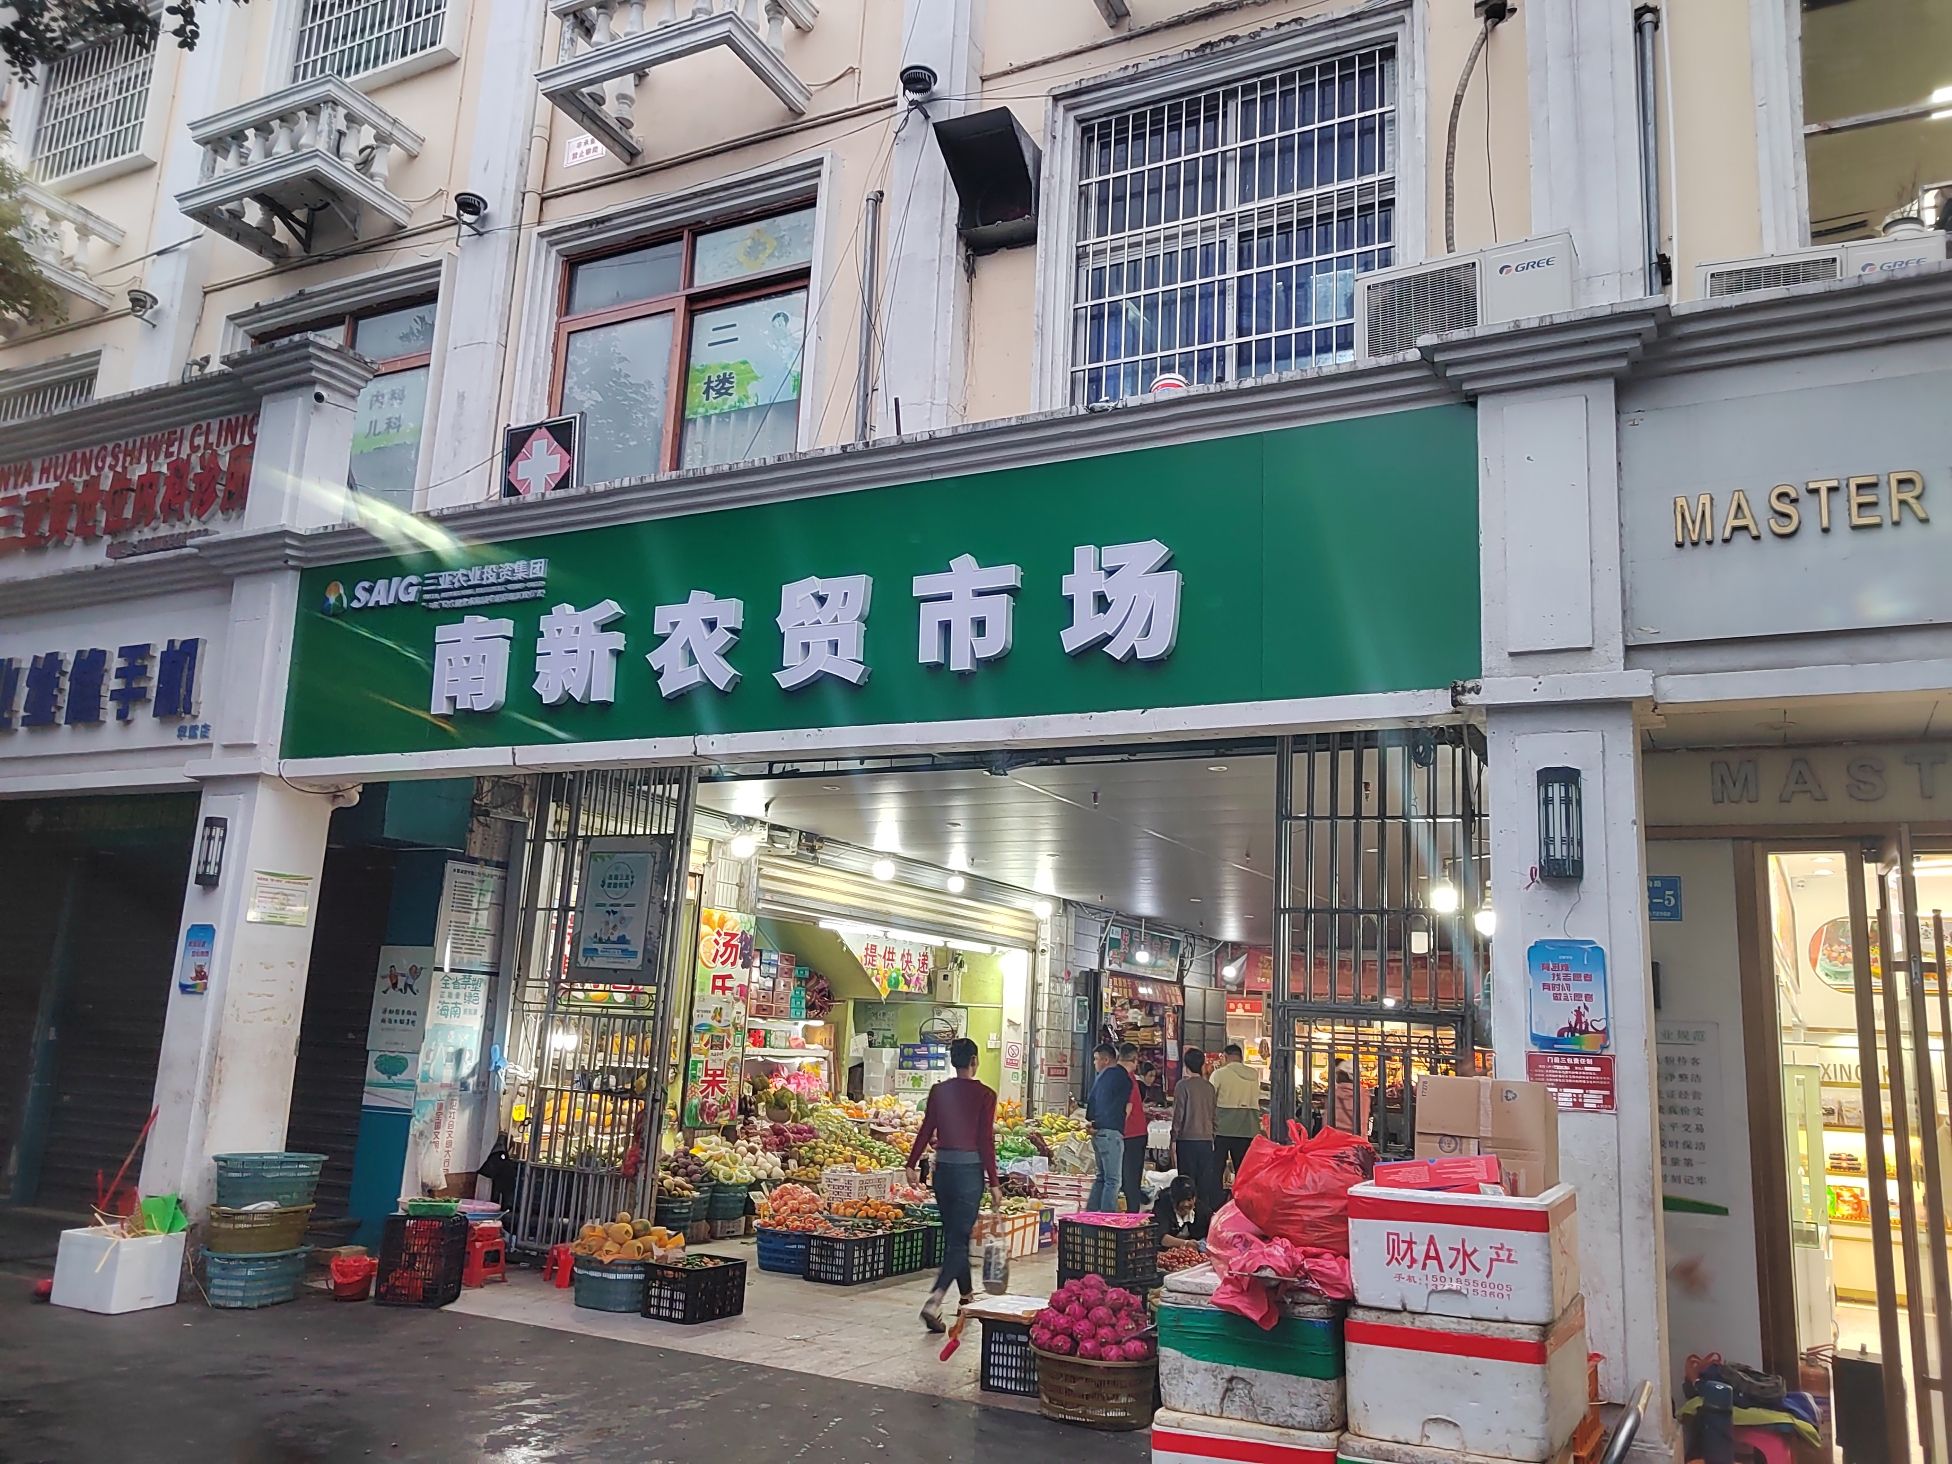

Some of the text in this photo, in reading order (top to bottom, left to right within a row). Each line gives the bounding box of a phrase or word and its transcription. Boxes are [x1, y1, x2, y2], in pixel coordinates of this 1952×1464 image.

[1515, 256, 1556, 272] GREE
[189, 412, 259, 454] CLINIC
[1673, 470, 1930, 548] MASTER
[350, 574, 422, 609] SAIG
[421, 558, 549, 591] 三亚农业投资集团
[430, 538, 1184, 716] 南新农贸市场
[1710, 752, 1948, 804] MAST
[863, 942, 930, 976] 提供快递
[1385, 1231, 1519, 1279] 财A水产
